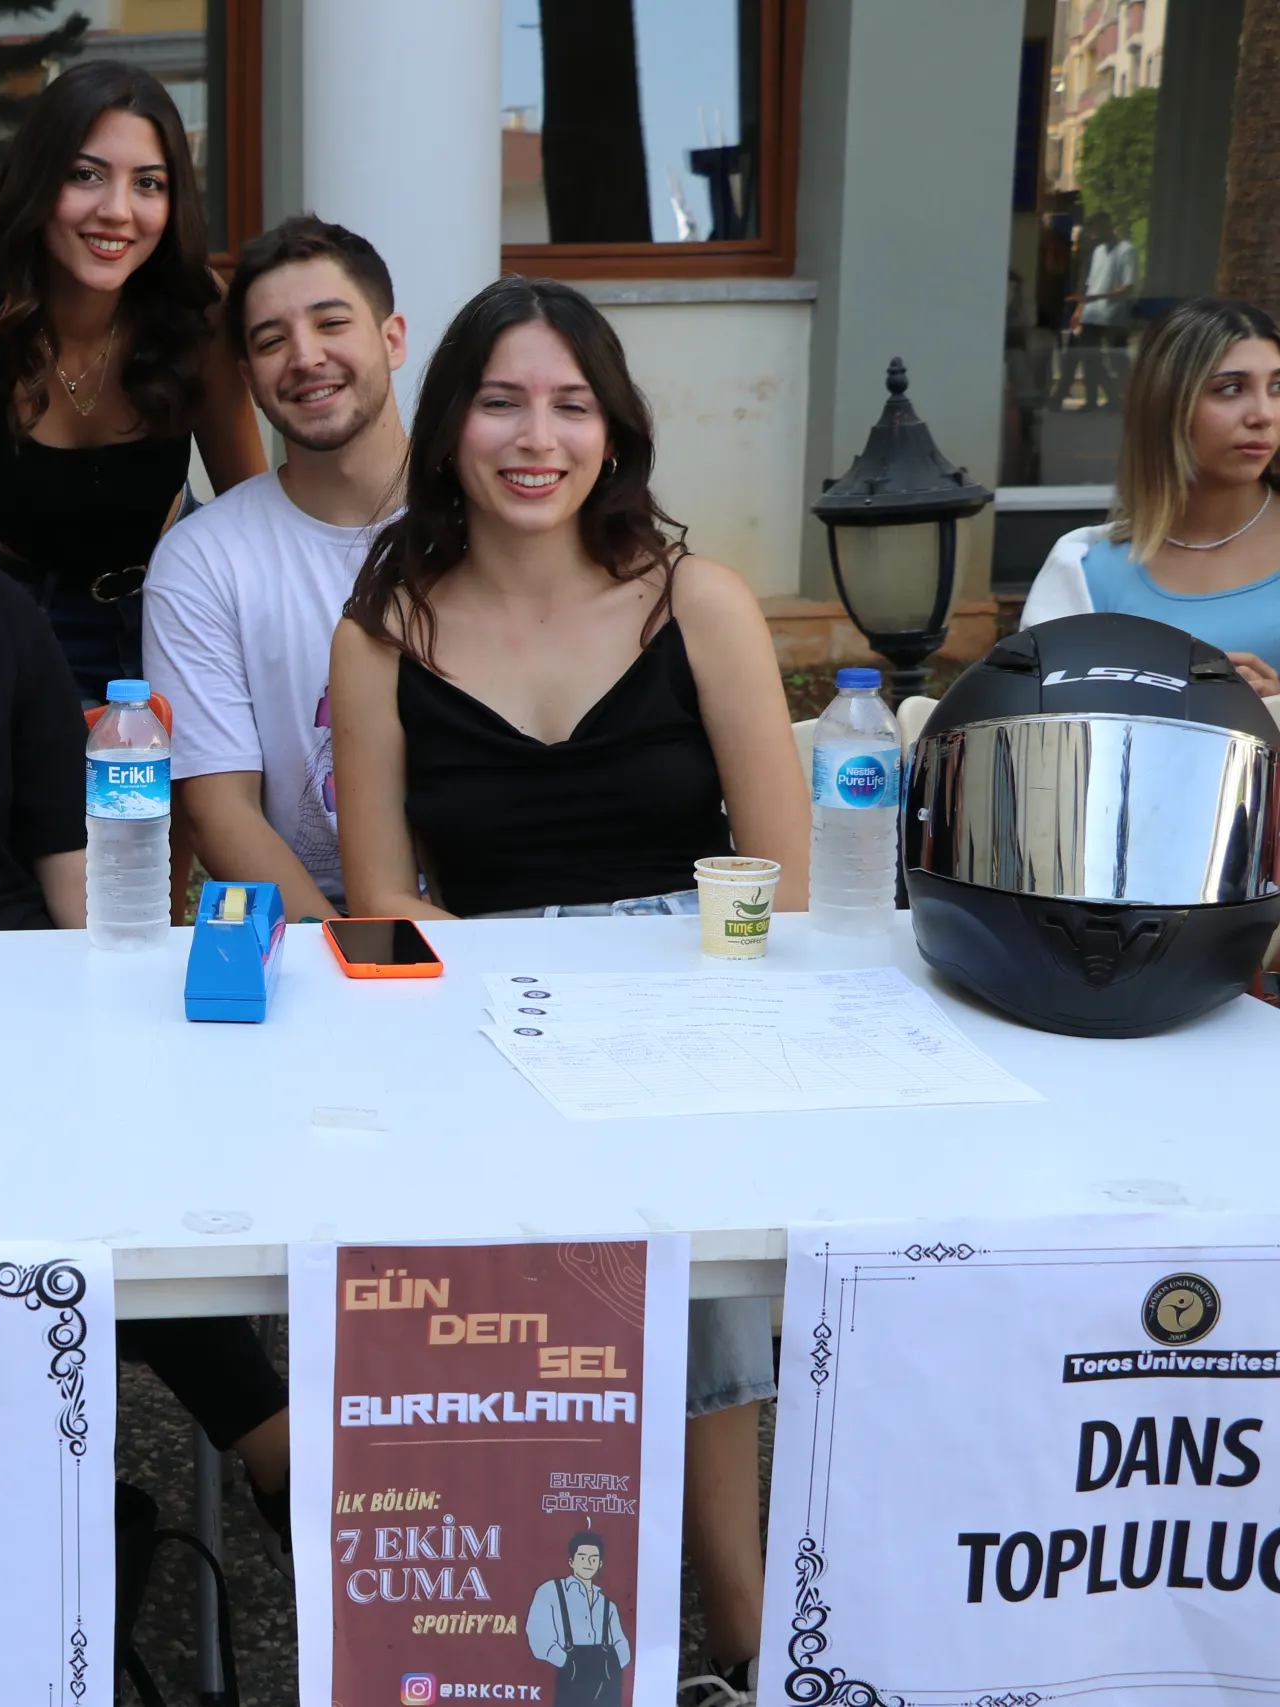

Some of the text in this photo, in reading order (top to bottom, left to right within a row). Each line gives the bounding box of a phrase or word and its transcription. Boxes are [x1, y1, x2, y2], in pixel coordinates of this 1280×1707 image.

[1042, 666, 1188, 692] LS2
[108, 765, 154, 785] Erikli
[838, 774, 865, 786] Pure
[866, 775, 884, 790] Life
[343, 1269, 450, 1311] GÜN
[428, 1313, 548, 1346] DEM
[537, 1345, 628, 1379] SEL
[1071, 1350, 1280, 1375] Toros Üniversitesi
[339, 1389, 637, 1428] BURAKLAMA
[1075, 1415, 1264, 1493] DANS
[549, 1472, 631, 1492] BURAK
[335, 1488, 440, 1515] İLK BÖLÜM:
[541, 1492, 637, 1515] ÇÖRTÜK
[335, 1513, 503, 1564] 7 EKİM
[346, 1566, 492, 1604] CUMA
[439, 1682, 542, 1701] @BRKCRTK
